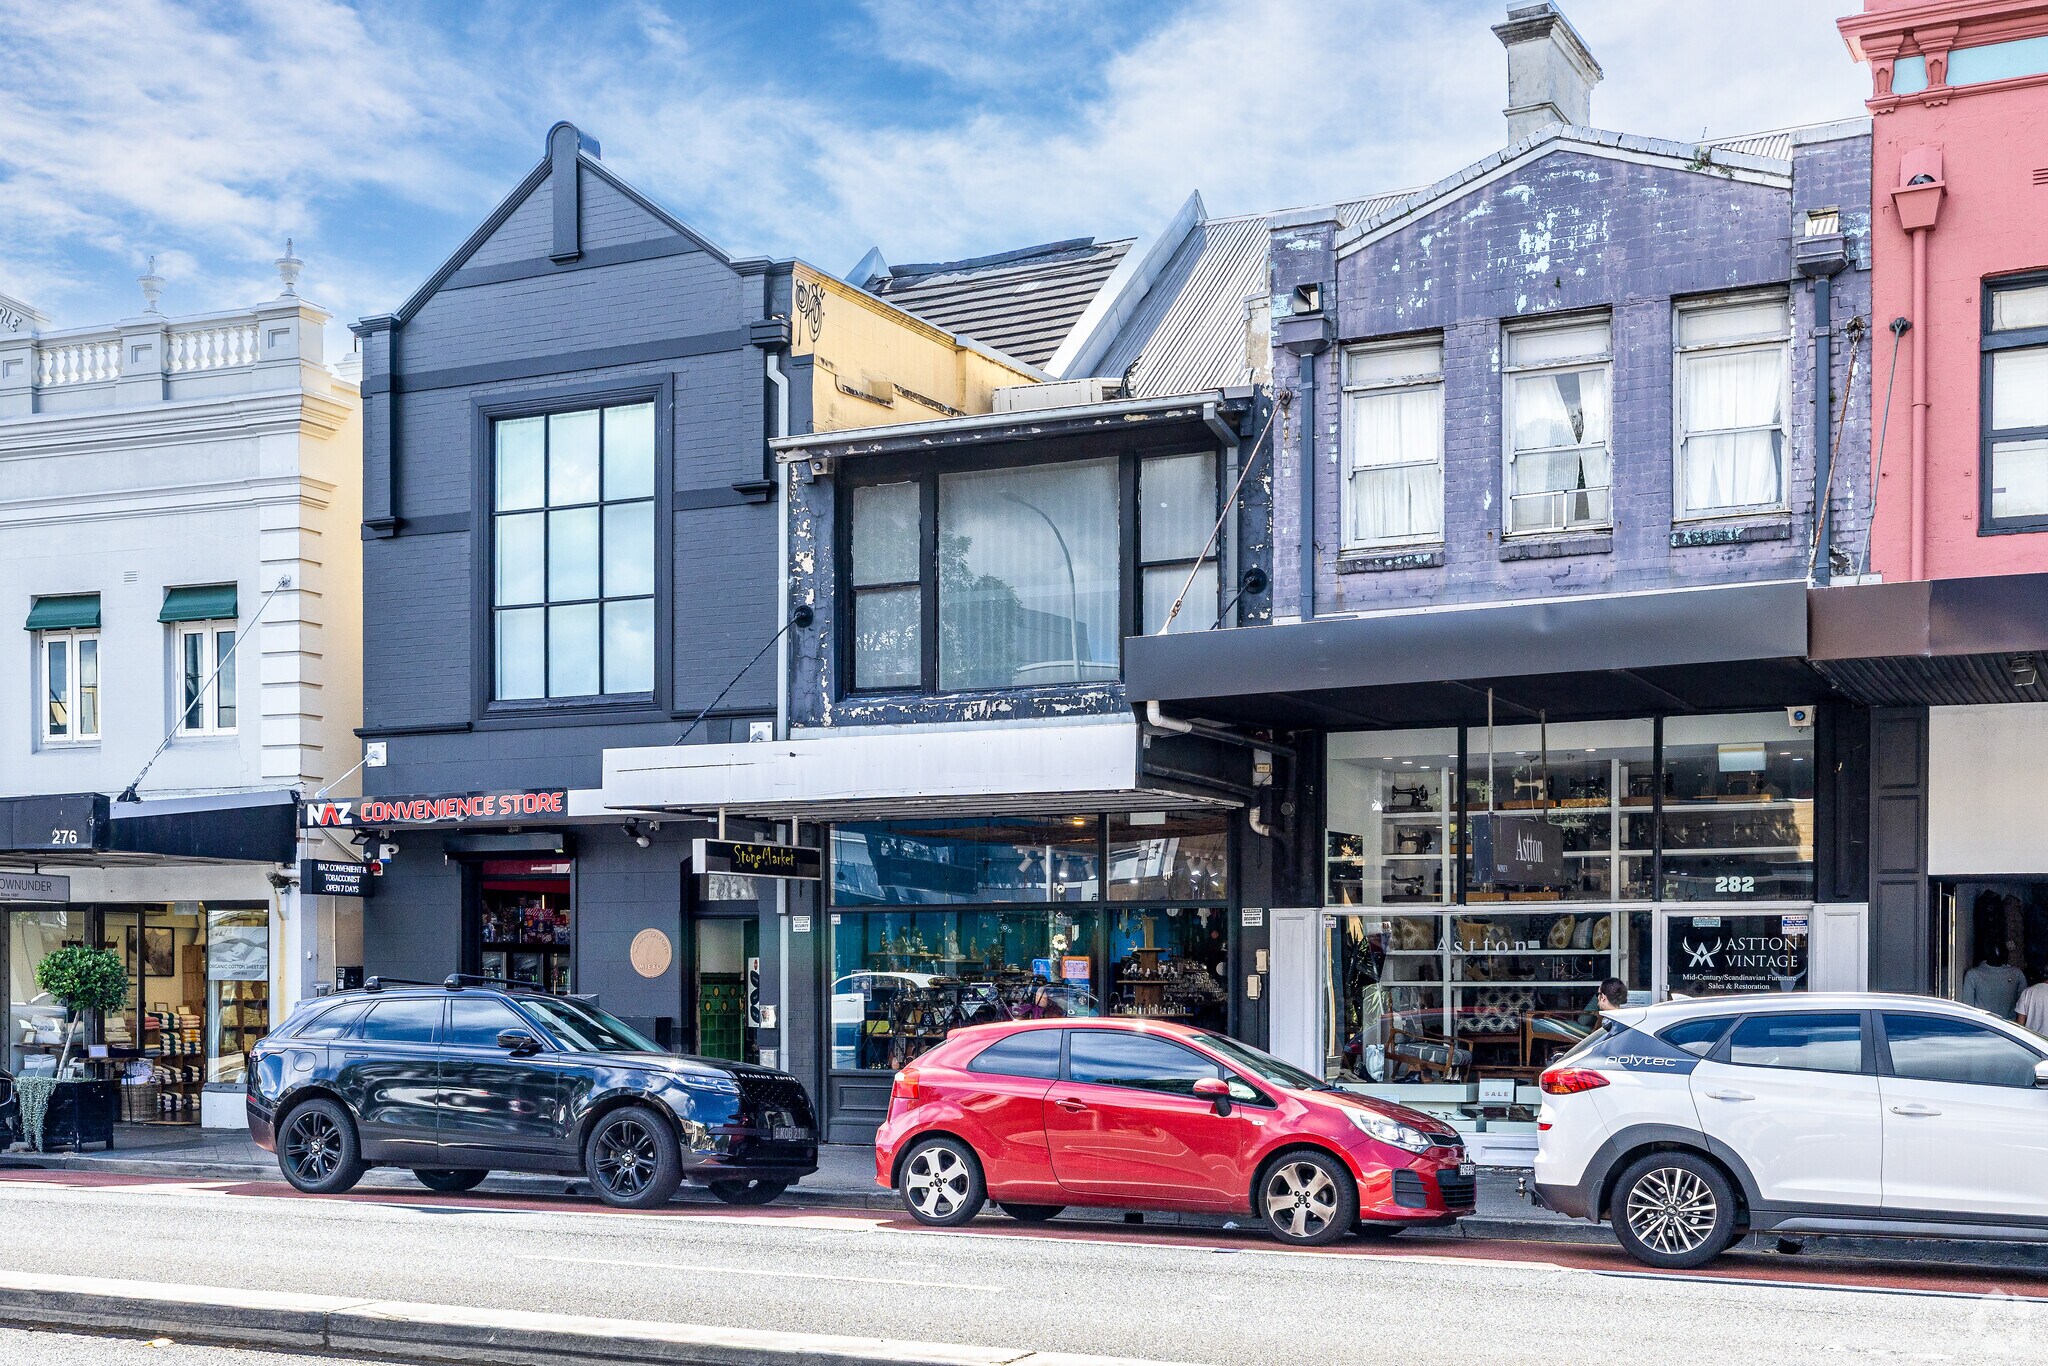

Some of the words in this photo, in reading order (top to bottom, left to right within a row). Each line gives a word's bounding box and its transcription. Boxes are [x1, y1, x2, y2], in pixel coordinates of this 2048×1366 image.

[307, 802, 353, 826] NAZ
[360, 795, 496, 822] CONVENIENCE
[498, 791, 564, 816] STORE
[52, 829, 78, 845] 276
[1515, 828, 1544, 863] Astton
[317, 863, 329, 871] NAZ
[329, 864, 362, 873] CONVENIENT
[324, 873, 360, 883] TOBACCONIST
[1715, 876, 1755, 892] 282
[325, 884, 340, 892] OPEN
[345, 885, 359, 893] DAYS
[1436, 936, 1529, 954] Astton
[1725, 937, 1798, 951] ASTTON
[1725, 954, 1798, 968] VINTAGE
[1682, 973, 1767, 981] Mid-Century/Scandinavian
[1708, 982, 1726, 990] Sales
[1604, 1054, 1677, 1067] polytec
